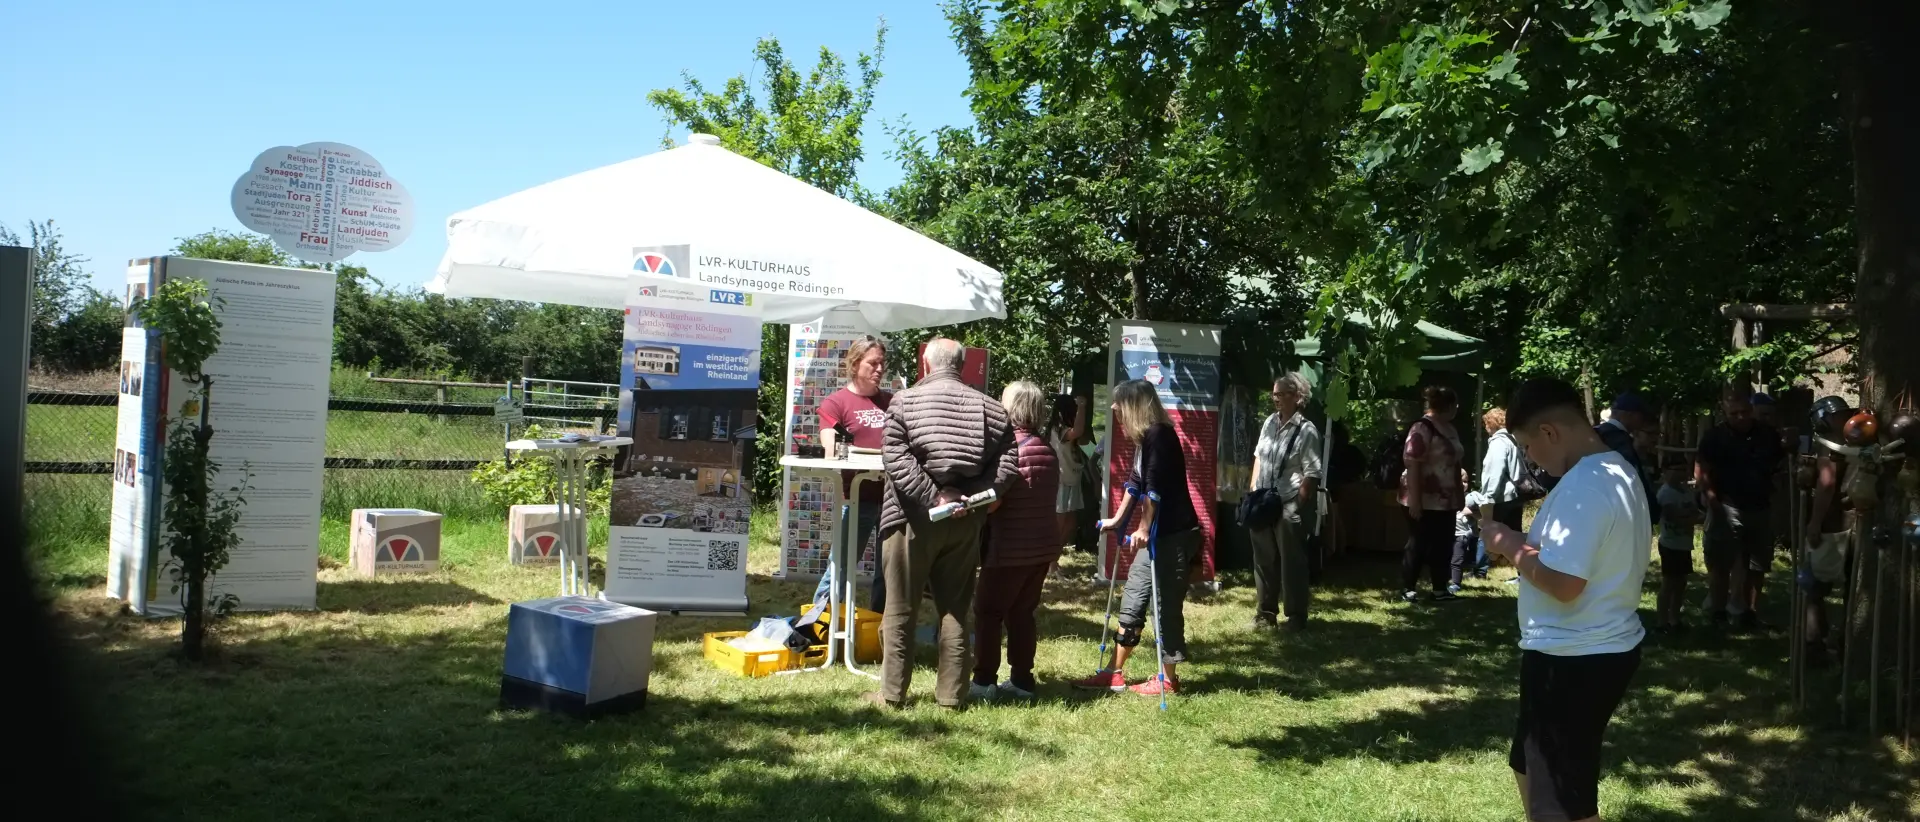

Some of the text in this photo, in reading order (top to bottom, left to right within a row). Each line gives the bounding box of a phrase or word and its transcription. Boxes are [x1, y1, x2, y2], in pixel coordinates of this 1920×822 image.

[287, 154, 318, 164] Religion
[336, 158, 360, 166] Liberal
[264, 166, 304, 178] Synagoge
[279, 160, 320, 172] Koscher
[339, 165, 382, 178] Schabbat
[250, 180, 284, 191] Pessach
[289, 178, 322, 190] Mann
[348, 176, 392, 190] Jiddisch
[244, 188, 286, 200] Stadtjuden
[286, 190, 312, 202] Tora
[320, 156, 336, 235] Landsynagoge
[348, 186, 376, 197] Kultur
[254, 198, 310, 212] Ausgrenzung
[372, 204, 398, 214] Küche
[272, 208, 290, 216] Jahr
[292, 210, 305, 218] 321
[312, 192, 321, 234] Hebräisch
[341, 207, 368, 218] Kunst
[337, 224, 388, 238] Landjuden
[300, 232, 328, 244] Frau
[336, 234, 364, 244] Musik
[699, 255, 811, 277] LVR-KULTURHAUS
[265, 282, 300, 290] Jahreszyklus
[699, 272, 844, 296] Landsynagoge Rödingen
[712, 290, 736, 304] LVR
[638, 309, 703, 322] LVR-Kulturhaus
[638, 318, 732, 334] Landsynagoge Rödingen
[706, 353, 749, 365] einzigartig
[693, 360, 748, 372] im westlichen
[707, 370, 748, 381] Rheinland
